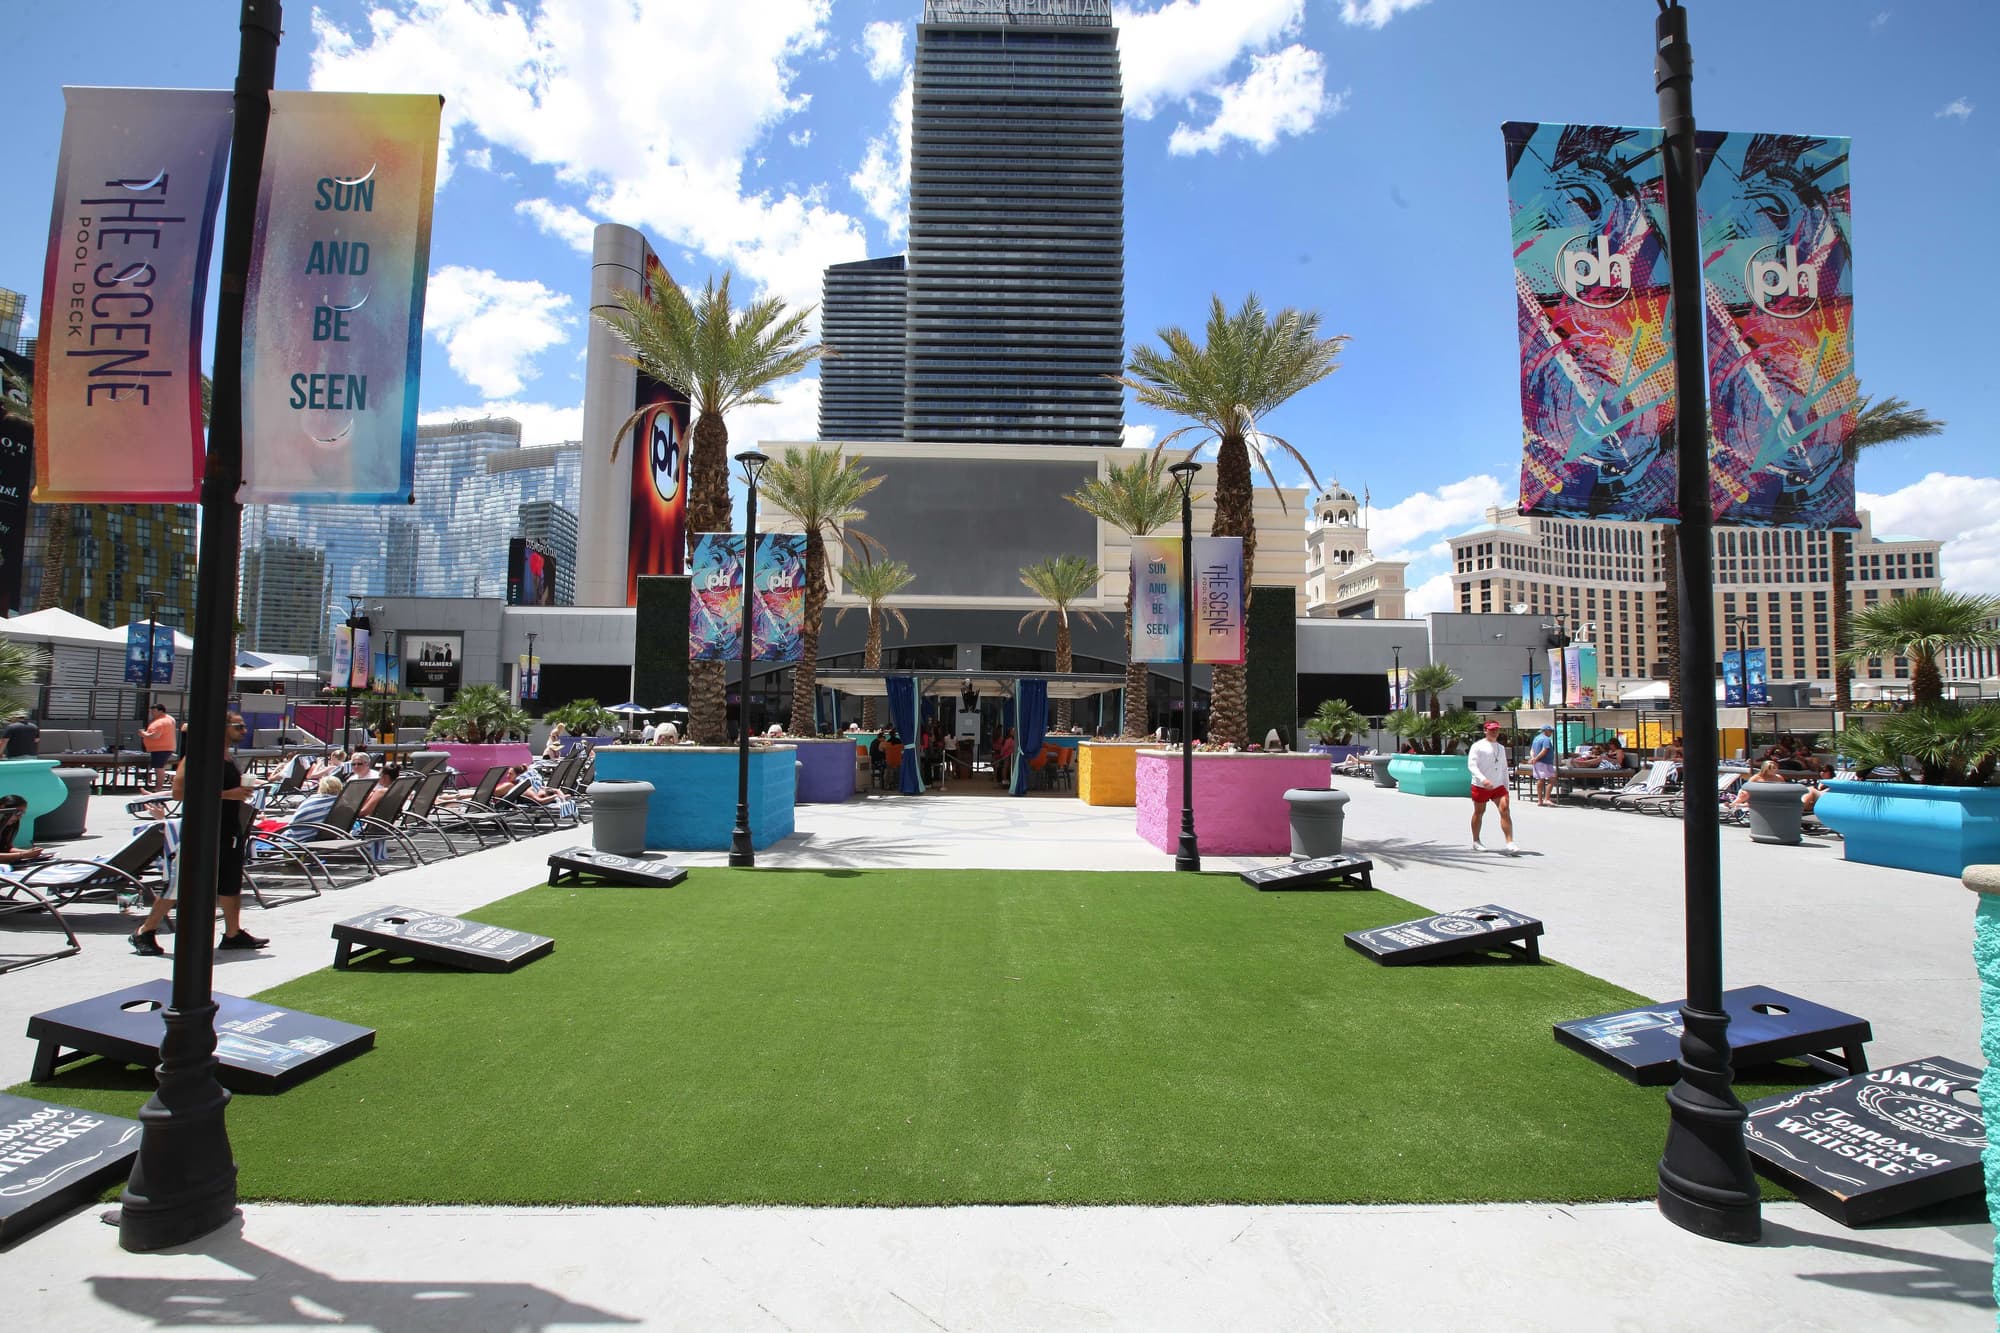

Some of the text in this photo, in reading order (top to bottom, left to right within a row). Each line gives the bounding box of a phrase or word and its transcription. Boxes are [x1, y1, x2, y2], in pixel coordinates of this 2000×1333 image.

[314, 177, 375, 212] SUN
[305, 240, 370, 277] AND
[1563, 234, 1632, 294] ph
[1752, 243, 1820, 303] ph
[66, 173, 185, 407] THE SCENE
[68, 217, 92, 338] POOL DECK
[312, 306, 352, 343] BE
[289, 372, 368, 411] SEEN
[1148, 562, 1167, 575] SUN
[1149, 583, 1167, 595] AND
[1201, 563, 1236, 636] THE SCENE
[1152, 602, 1164, 615] BE
[1146, 623, 1169, 636] SEEN
[1866, 1069, 1960, 1096] JACK
[1894, 1112, 1947, 1133] BRAND
[1918, 1104, 1967, 1124] Old
[0, 1121, 64, 1156] OUR MASH
[1822, 1127, 1905, 1162] SOUR MASH
